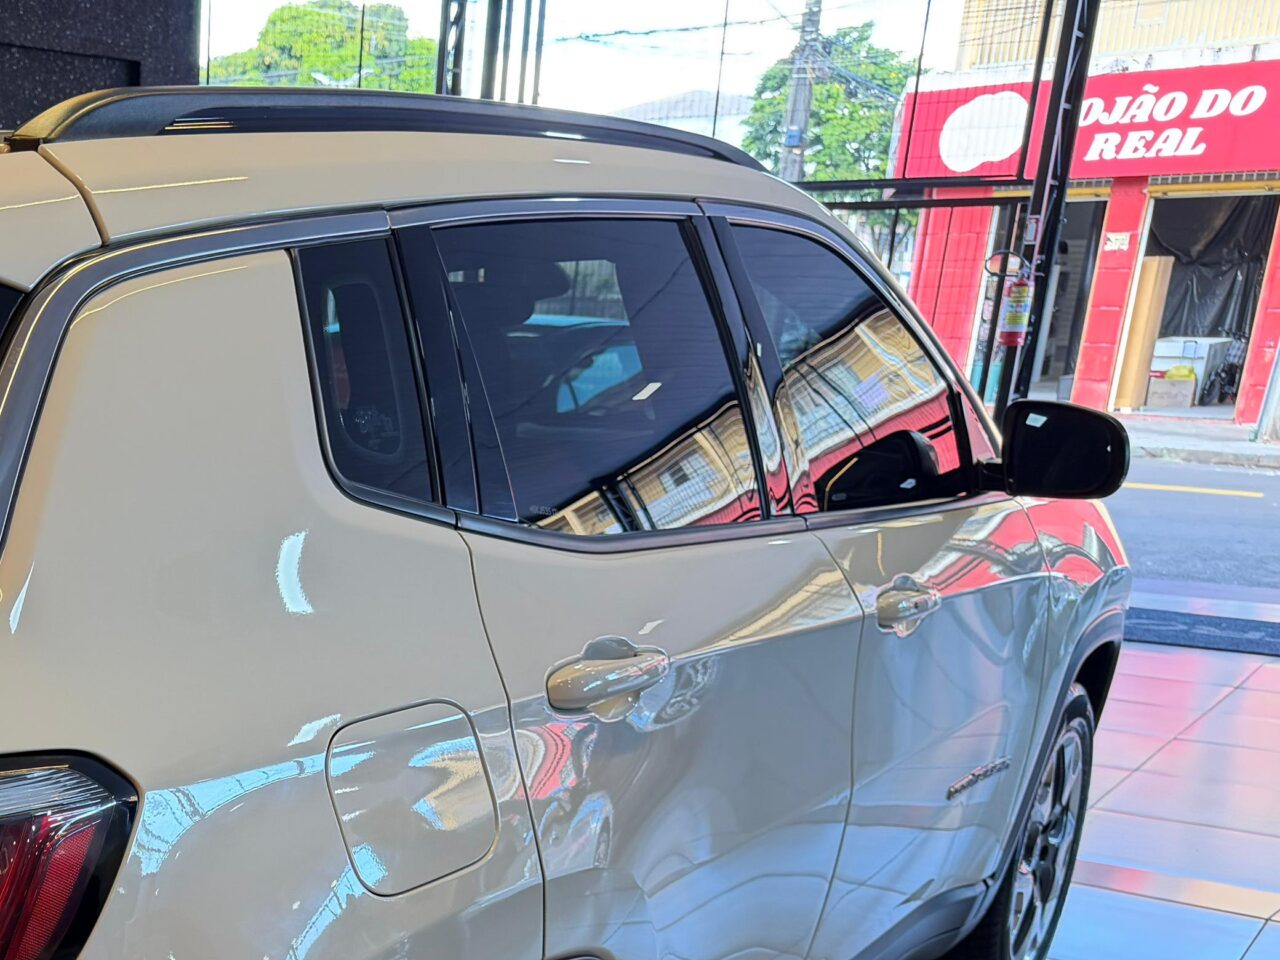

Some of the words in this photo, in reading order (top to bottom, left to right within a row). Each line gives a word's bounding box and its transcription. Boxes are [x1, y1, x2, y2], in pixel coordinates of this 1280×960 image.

[1078, 83, 1189, 128] OJÃO
[1190, 84, 1268, 120] DO
[1082, 127, 1207, 162] REAL
